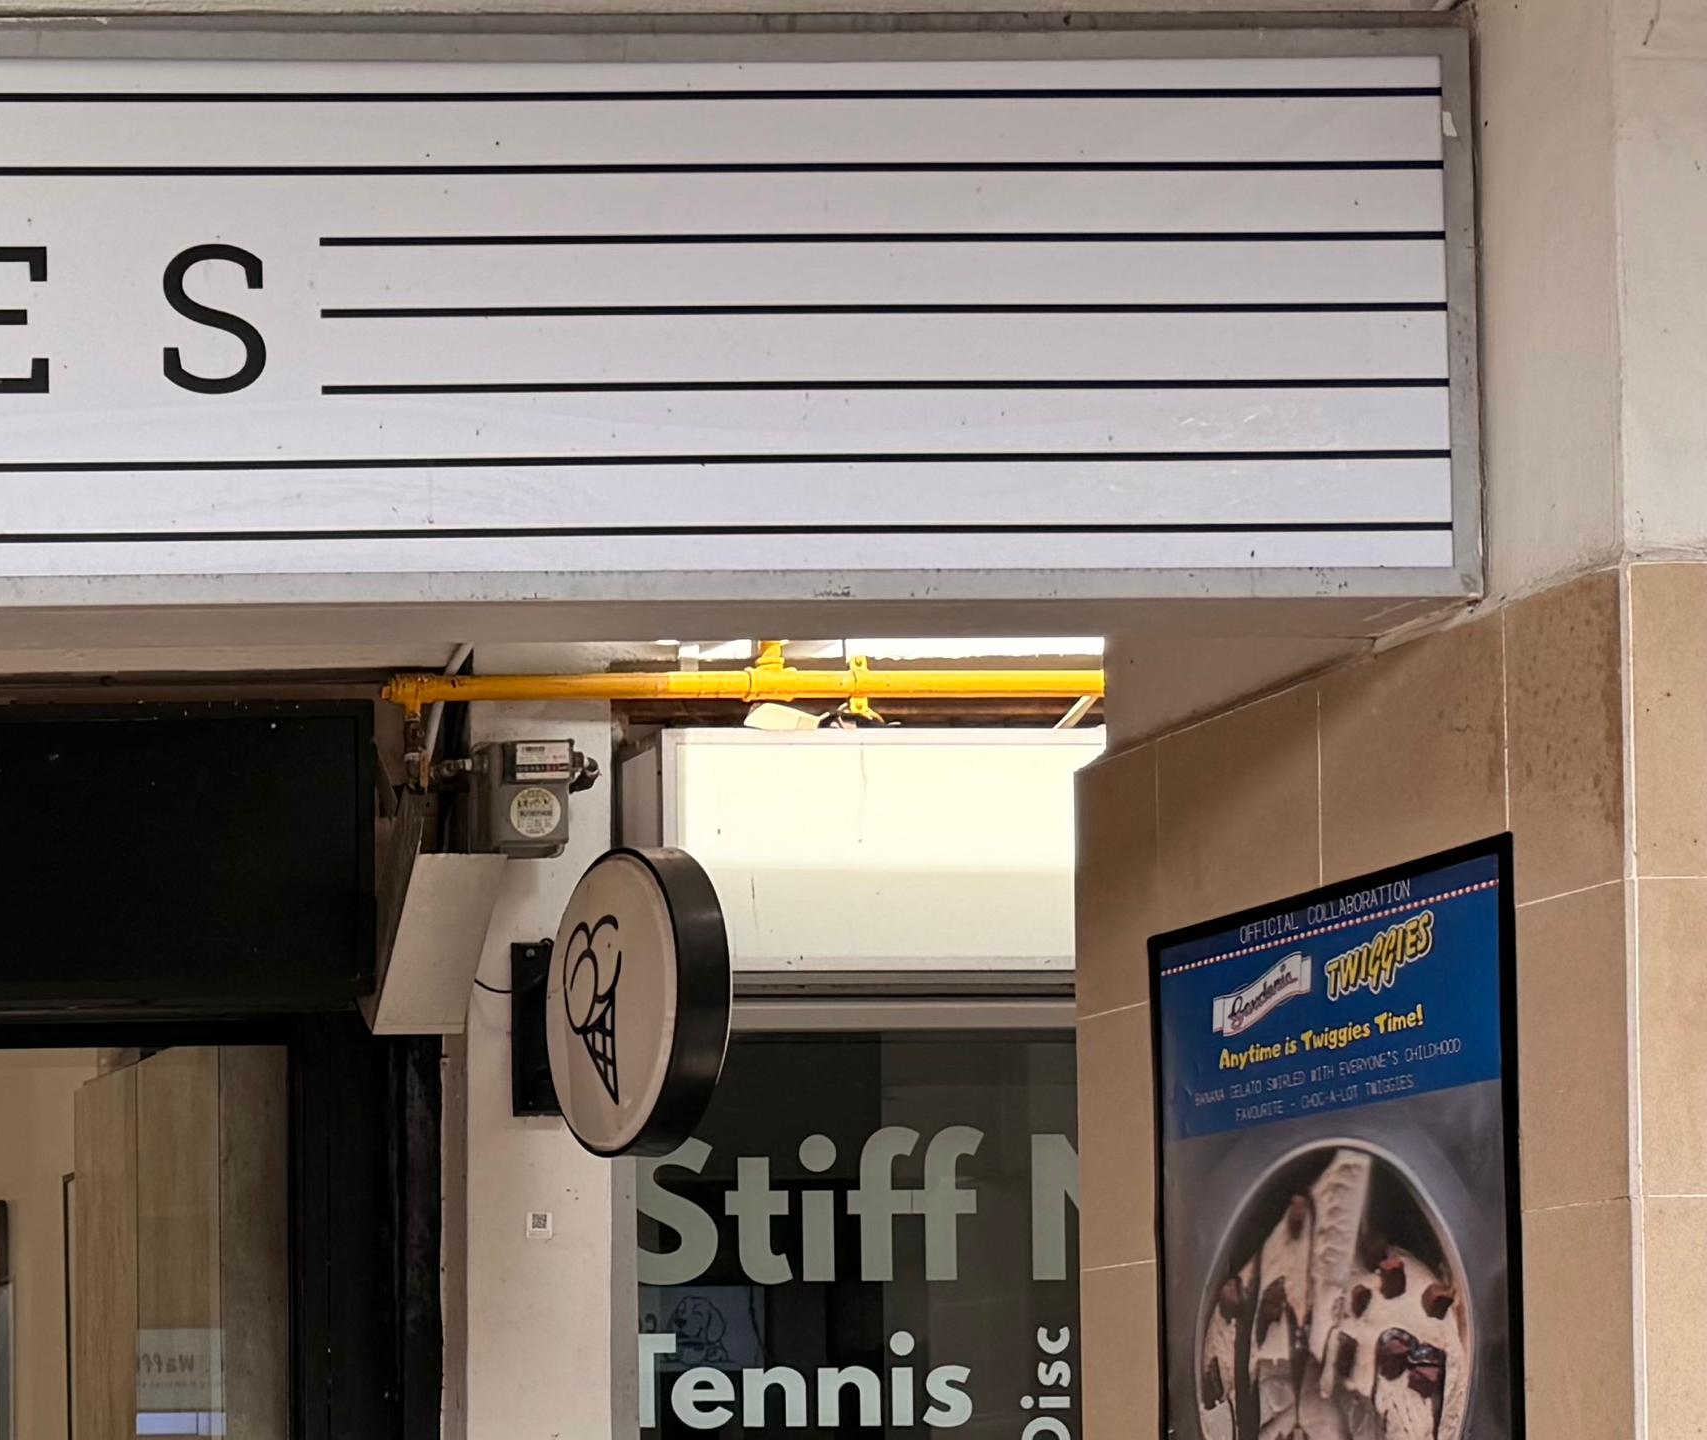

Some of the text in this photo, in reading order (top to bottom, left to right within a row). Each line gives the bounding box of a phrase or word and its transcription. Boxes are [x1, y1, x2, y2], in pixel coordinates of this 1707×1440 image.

[1239, 879, 1411, 945] OFFICIAL COLLABORATION
[1325, 911, 1434, 1001] TWIGGIES
[1219, 1004, 1424, 1071] Anytime is Twiggies Time!
[1230, 1081, 1262, 1100] GELATO
[1405, 1037, 1461, 1063] CHILDHOOD
[636, 1125, 984, 1285] Stiff
[638, 1330, 973, 1429] Tennis
